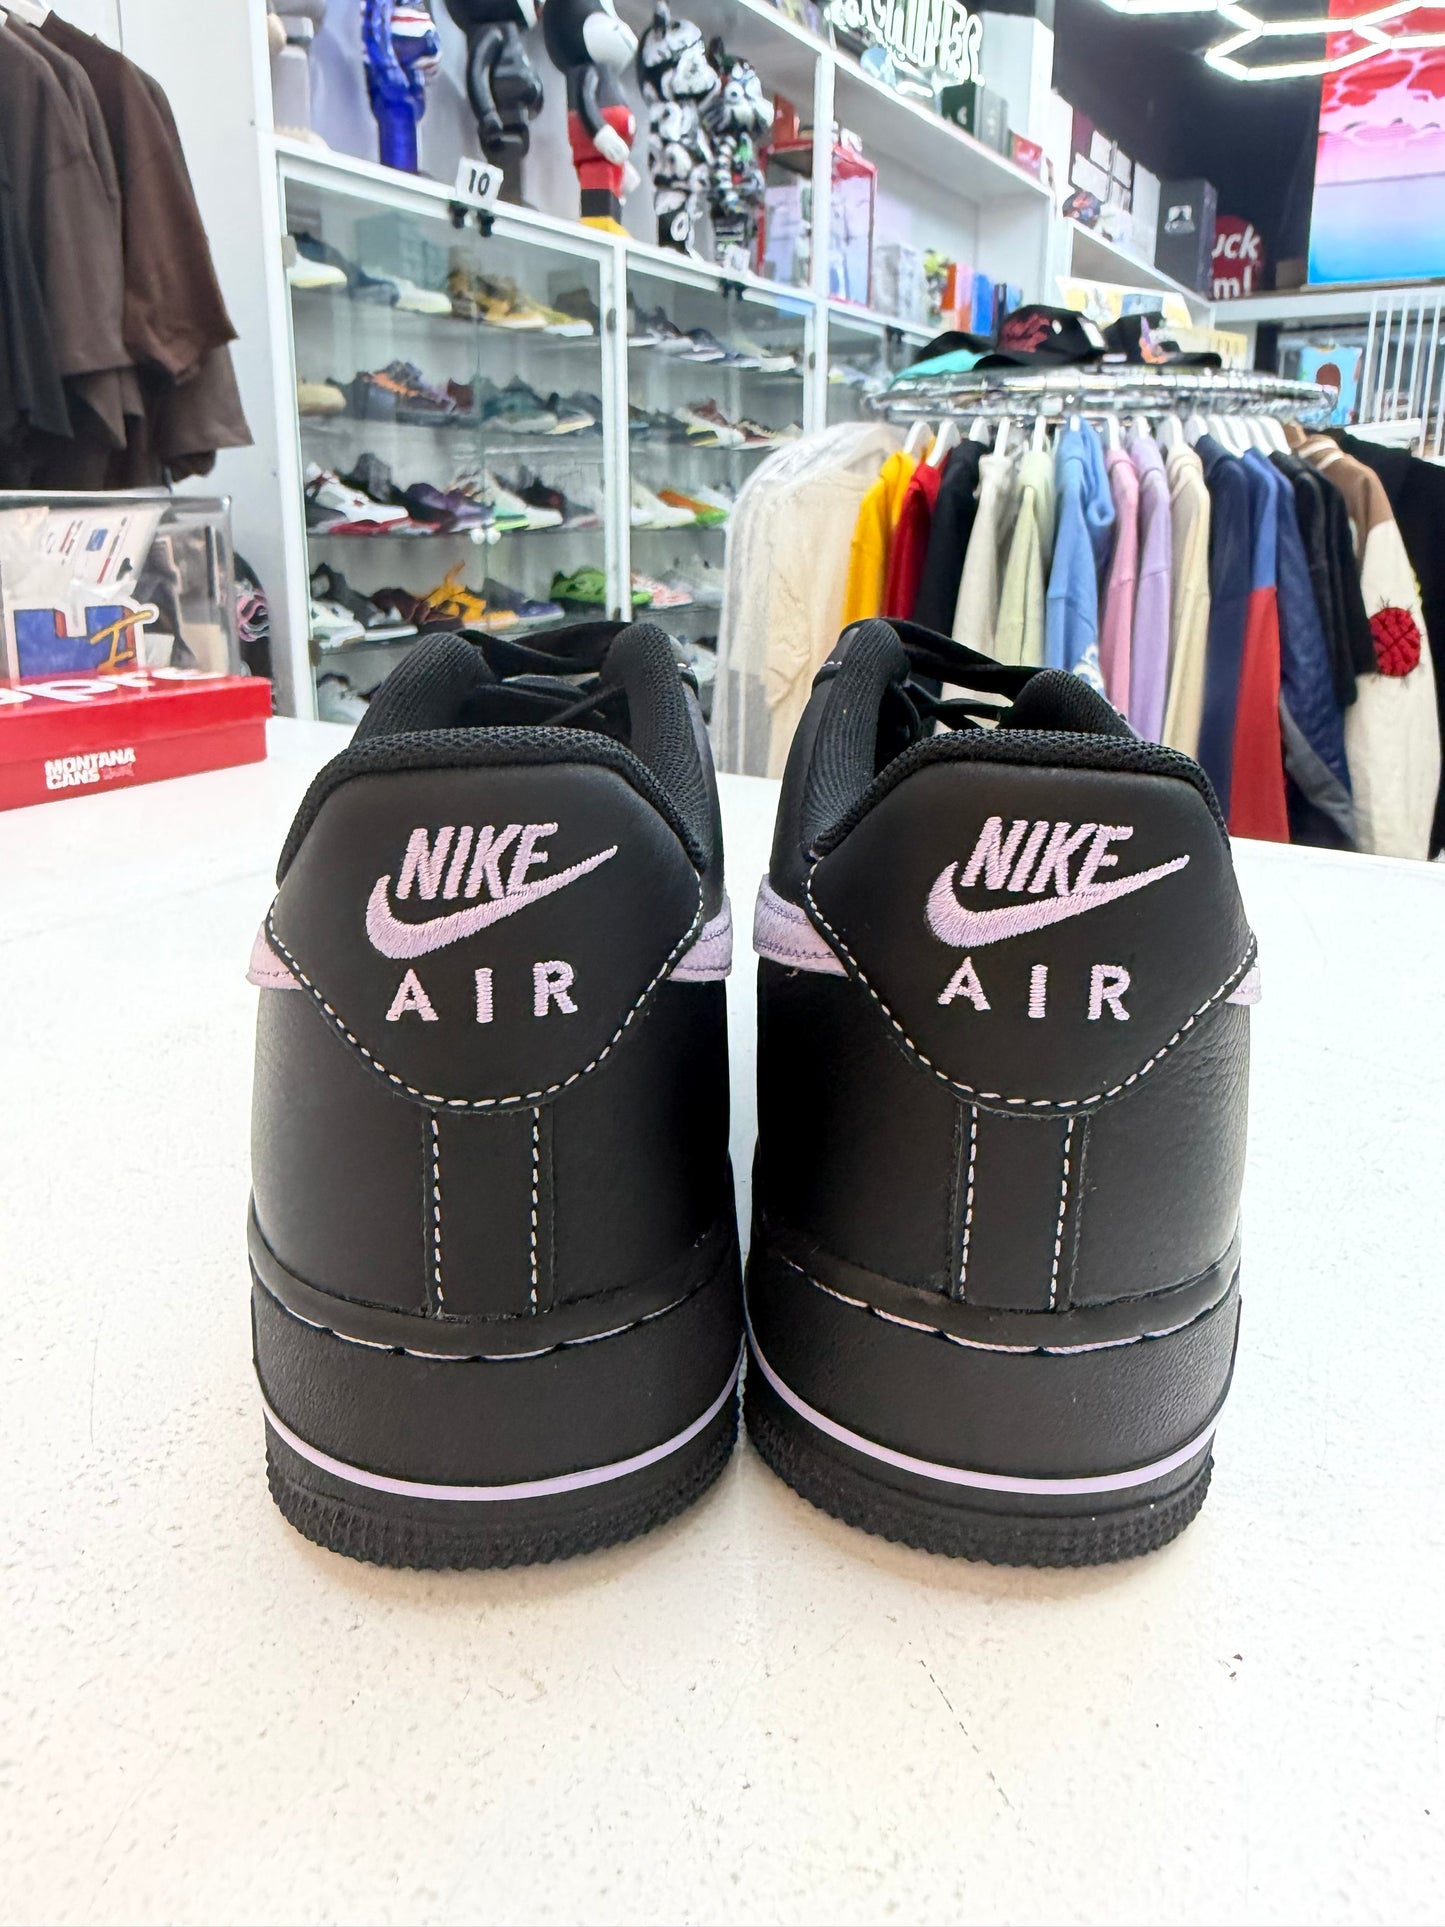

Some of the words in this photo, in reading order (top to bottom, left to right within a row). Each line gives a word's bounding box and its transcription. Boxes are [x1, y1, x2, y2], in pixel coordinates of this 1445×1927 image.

[468, 168, 491, 196] 10
[1211, 224, 1261, 260] uck
[44, 747, 136, 776] MONTANA
[46, 768, 101, 790] CANS
[395, 822, 559, 900] NIKE
[960, 816, 1134, 897] NIKE
[385, 960, 579, 1024] AIR
[937, 956, 1131, 1021] AIR
